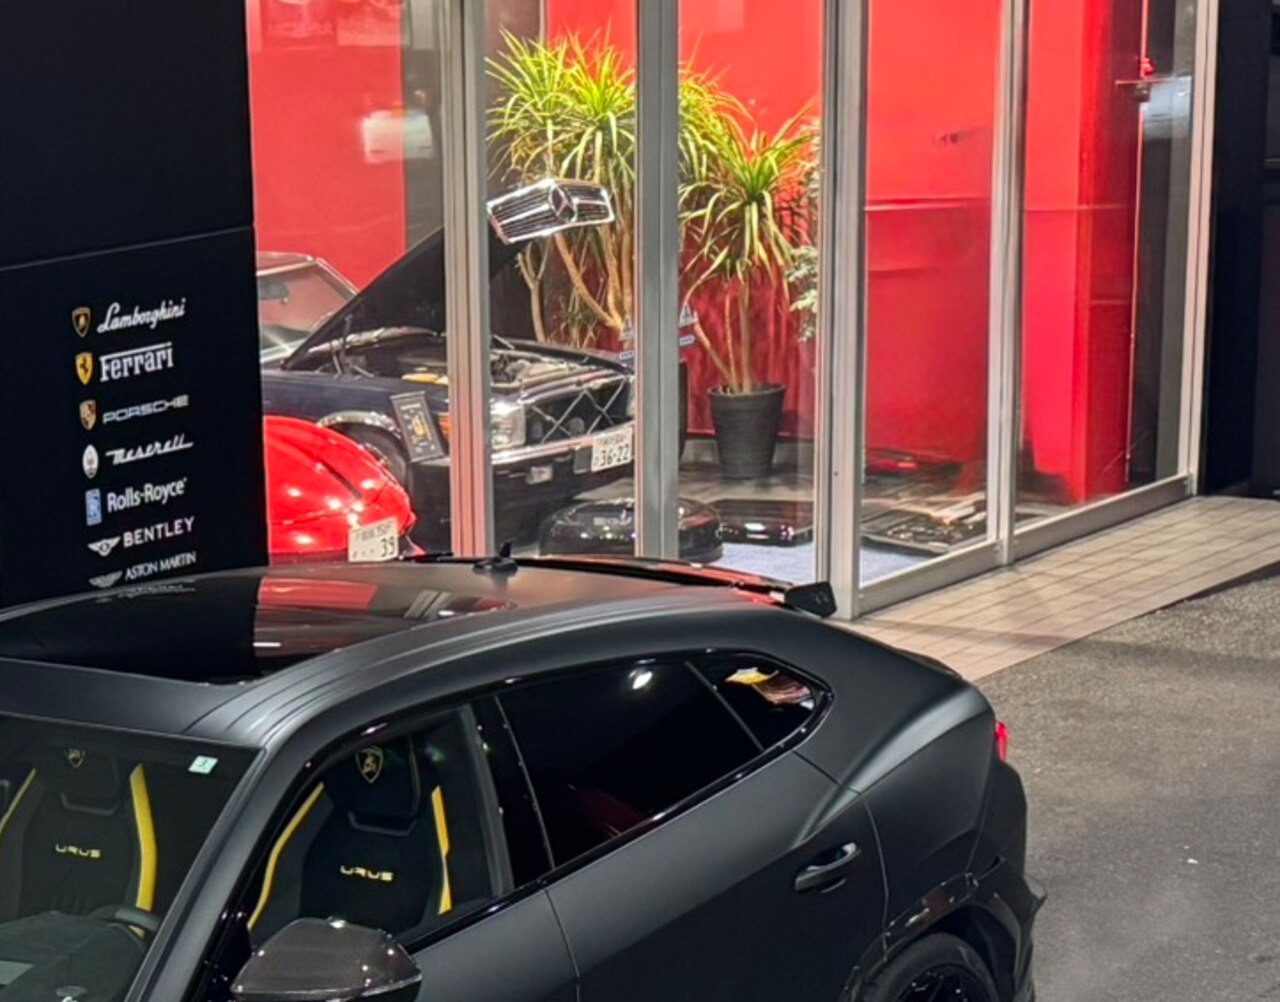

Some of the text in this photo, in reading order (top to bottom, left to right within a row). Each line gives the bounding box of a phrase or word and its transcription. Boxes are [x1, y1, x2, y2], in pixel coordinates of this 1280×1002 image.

[96, 297, 187, 334] Lamborghini
[99, 341, 174, 383] Ferrari
[102, 394, 189, 425] PORSCHE
[105, 433, 194, 466] Maserati
[107, 481, 185, 513] Rolls-Royce
[123, 516, 195, 549] BENTLEY
[125, 551, 197, 581] ASTON MARTIN
[55, 843, 102, 859] URUS
[339, 865, 394, 882] URUS
